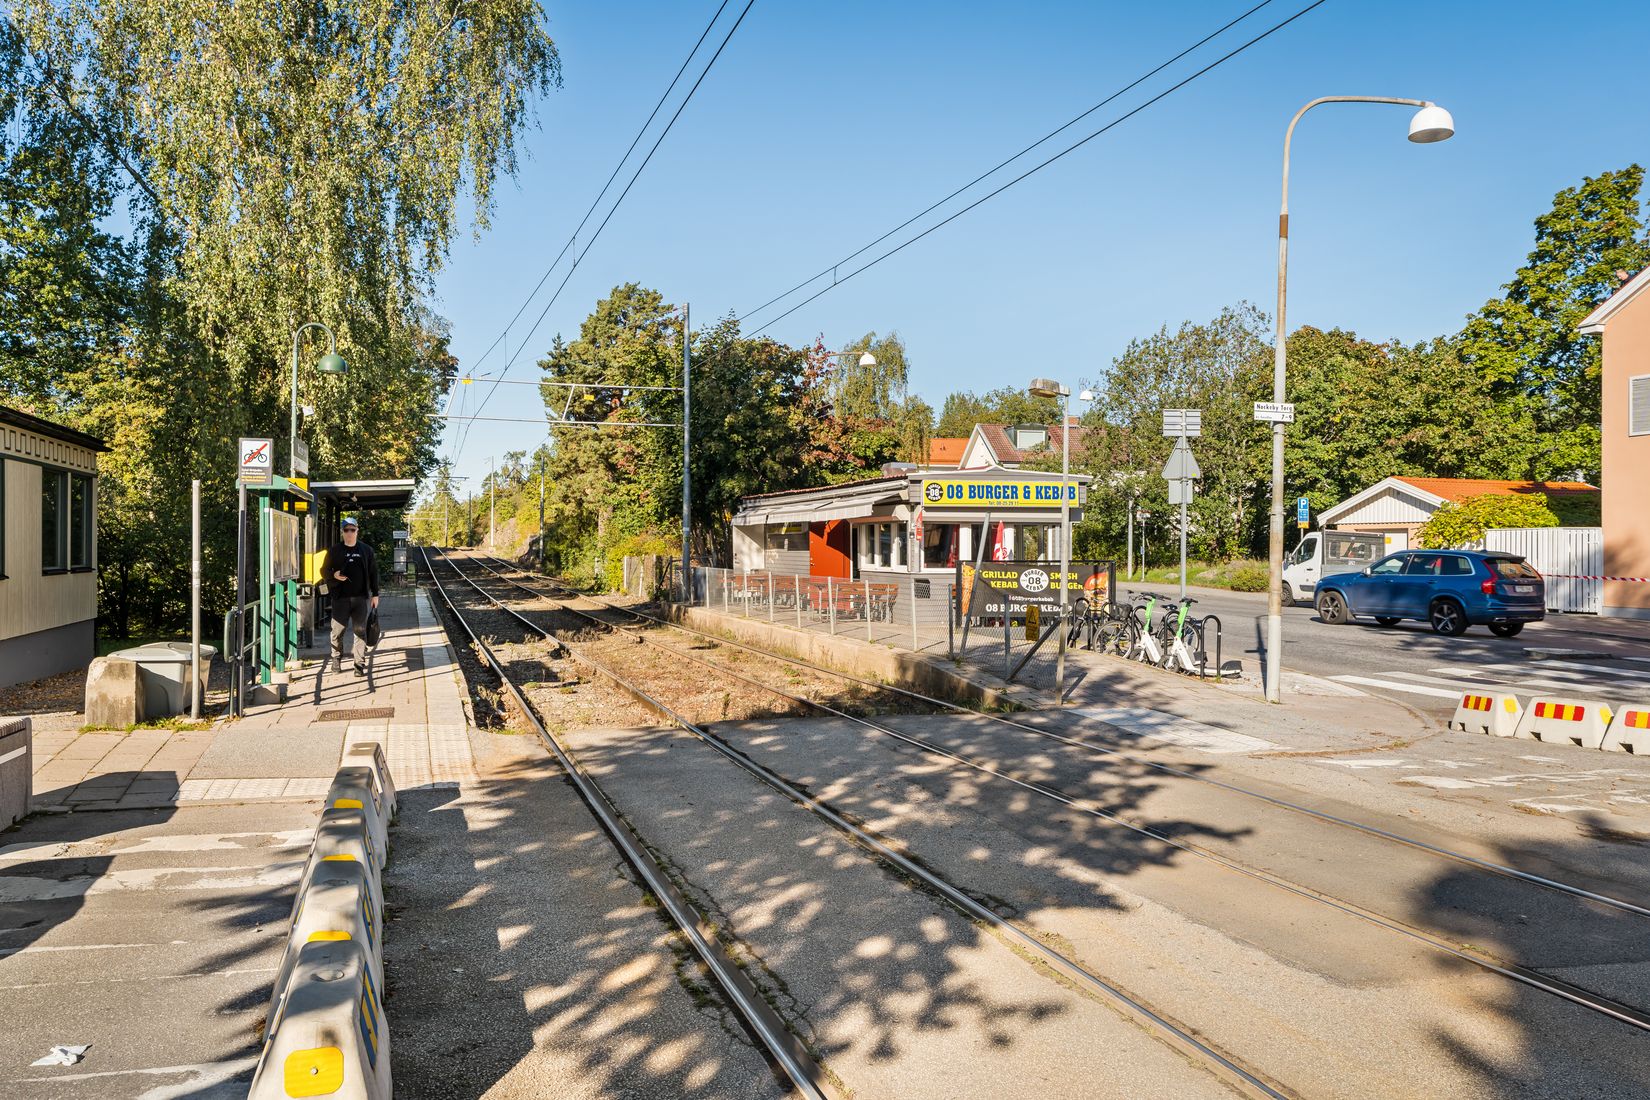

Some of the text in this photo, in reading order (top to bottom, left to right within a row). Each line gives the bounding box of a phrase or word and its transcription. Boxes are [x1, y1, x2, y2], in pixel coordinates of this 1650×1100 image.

[947, 484, 963, 499] 08
[968, 484, 1018, 500] BURGER
[1023, 485, 1030, 499] &
[1301, 500, 1306, 508] P
[986, 604, 998, 612] 08
